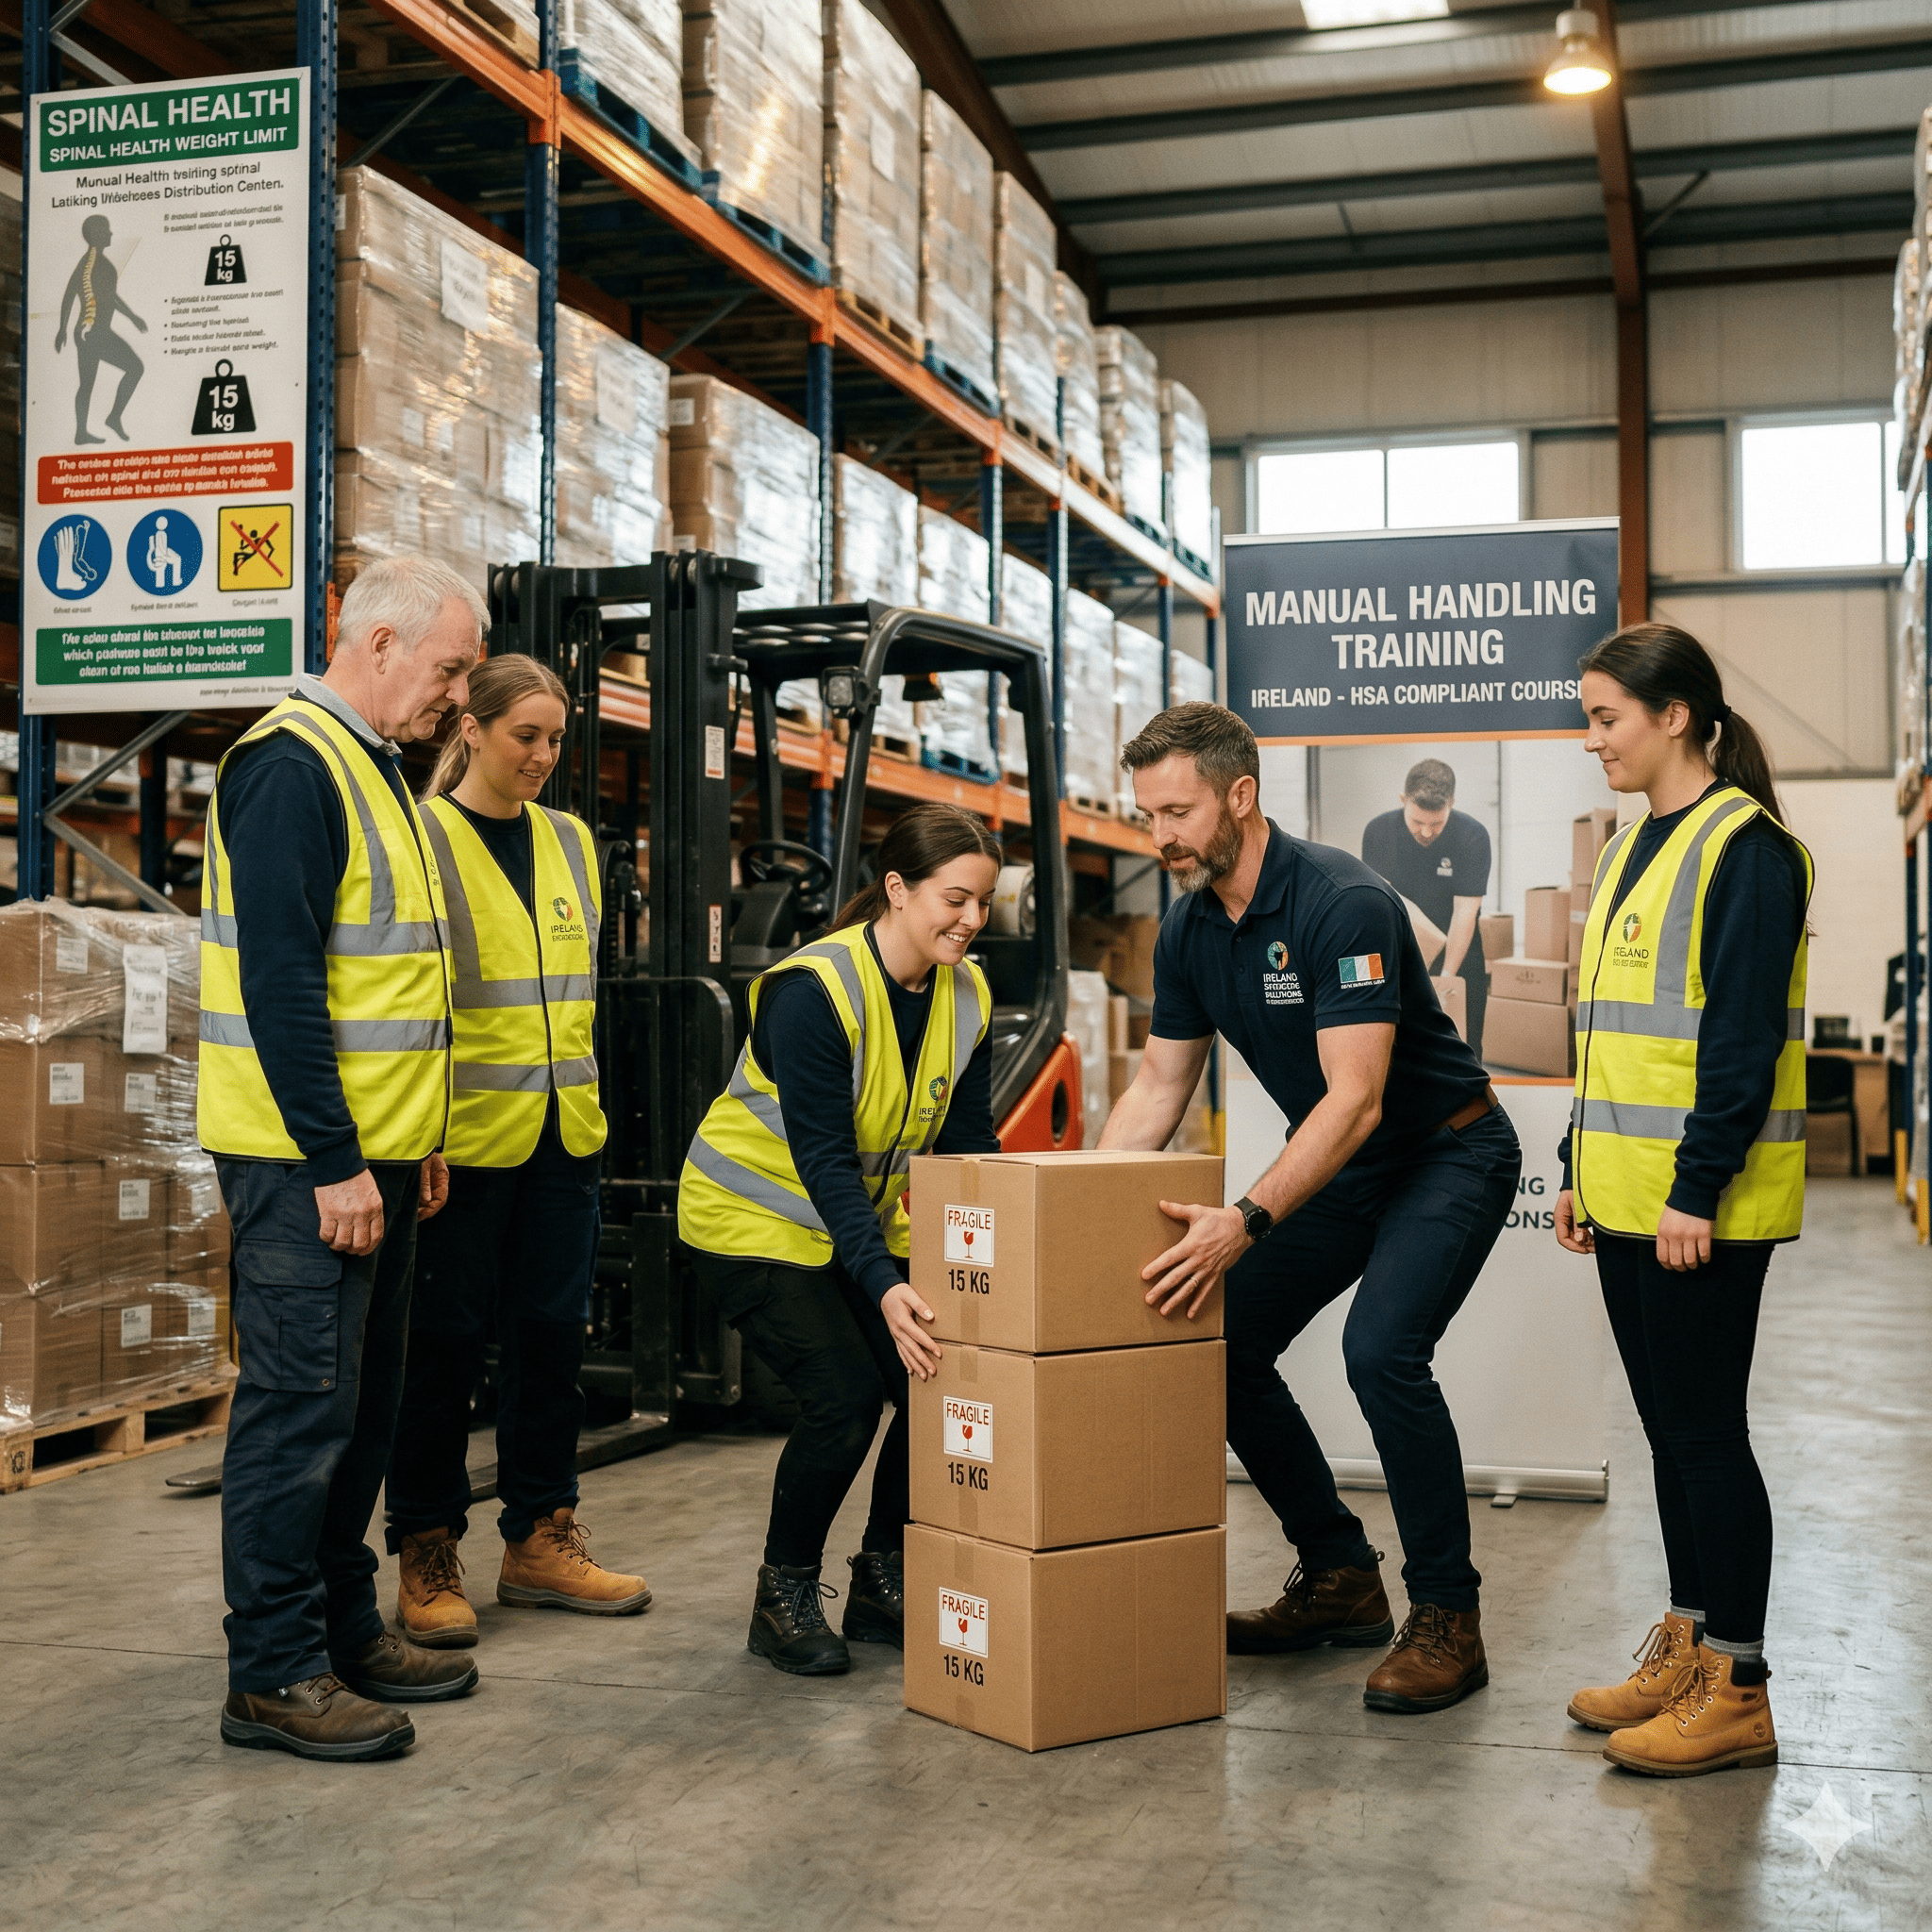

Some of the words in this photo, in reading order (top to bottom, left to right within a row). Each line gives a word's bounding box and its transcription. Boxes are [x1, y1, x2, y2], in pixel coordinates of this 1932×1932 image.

[47, 102, 158, 137] SPINAL
[168, 88, 291, 125] HEALTH
[50, 146, 106, 162] SPINAL
[109, 138, 171, 157] HEALTH
[175, 131, 240, 151] WEIGHT
[243, 126, 288, 144] LIMIT
[164, 182, 234, 198] Distribution
[215, 250, 236, 267] 15
[217, 268, 234, 282] kg
[208, 384, 239, 409] 15
[211, 410, 235, 432] kg
[1246, 587, 1397, 626] MANUAL
[1409, 578, 1596, 621] HANDLING
[1331, 629, 1505, 670] TRAINING
[1251, 687, 1331, 708] IRELAND
[1351, 685, 1390, 706] HSA
[1393, 682, 1506, 705] COMPLIANT
[1263, 973, 1298, 983] IRELAND
[947, 1210, 991, 1230] FRAGILE
[948, 1269, 966, 1292] 15
[970, 1271, 990, 1295] KG
[946, 1402, 990, 1425] FRAGILE
[948, 1461, 965, 1486] 15
[968, 1465, 989, 1491] KG
[942, 1594, 985, 1621] FRAGILE
[943, 1654, 959, 1678] 15
[964, 1658, 984, 1687] KG
